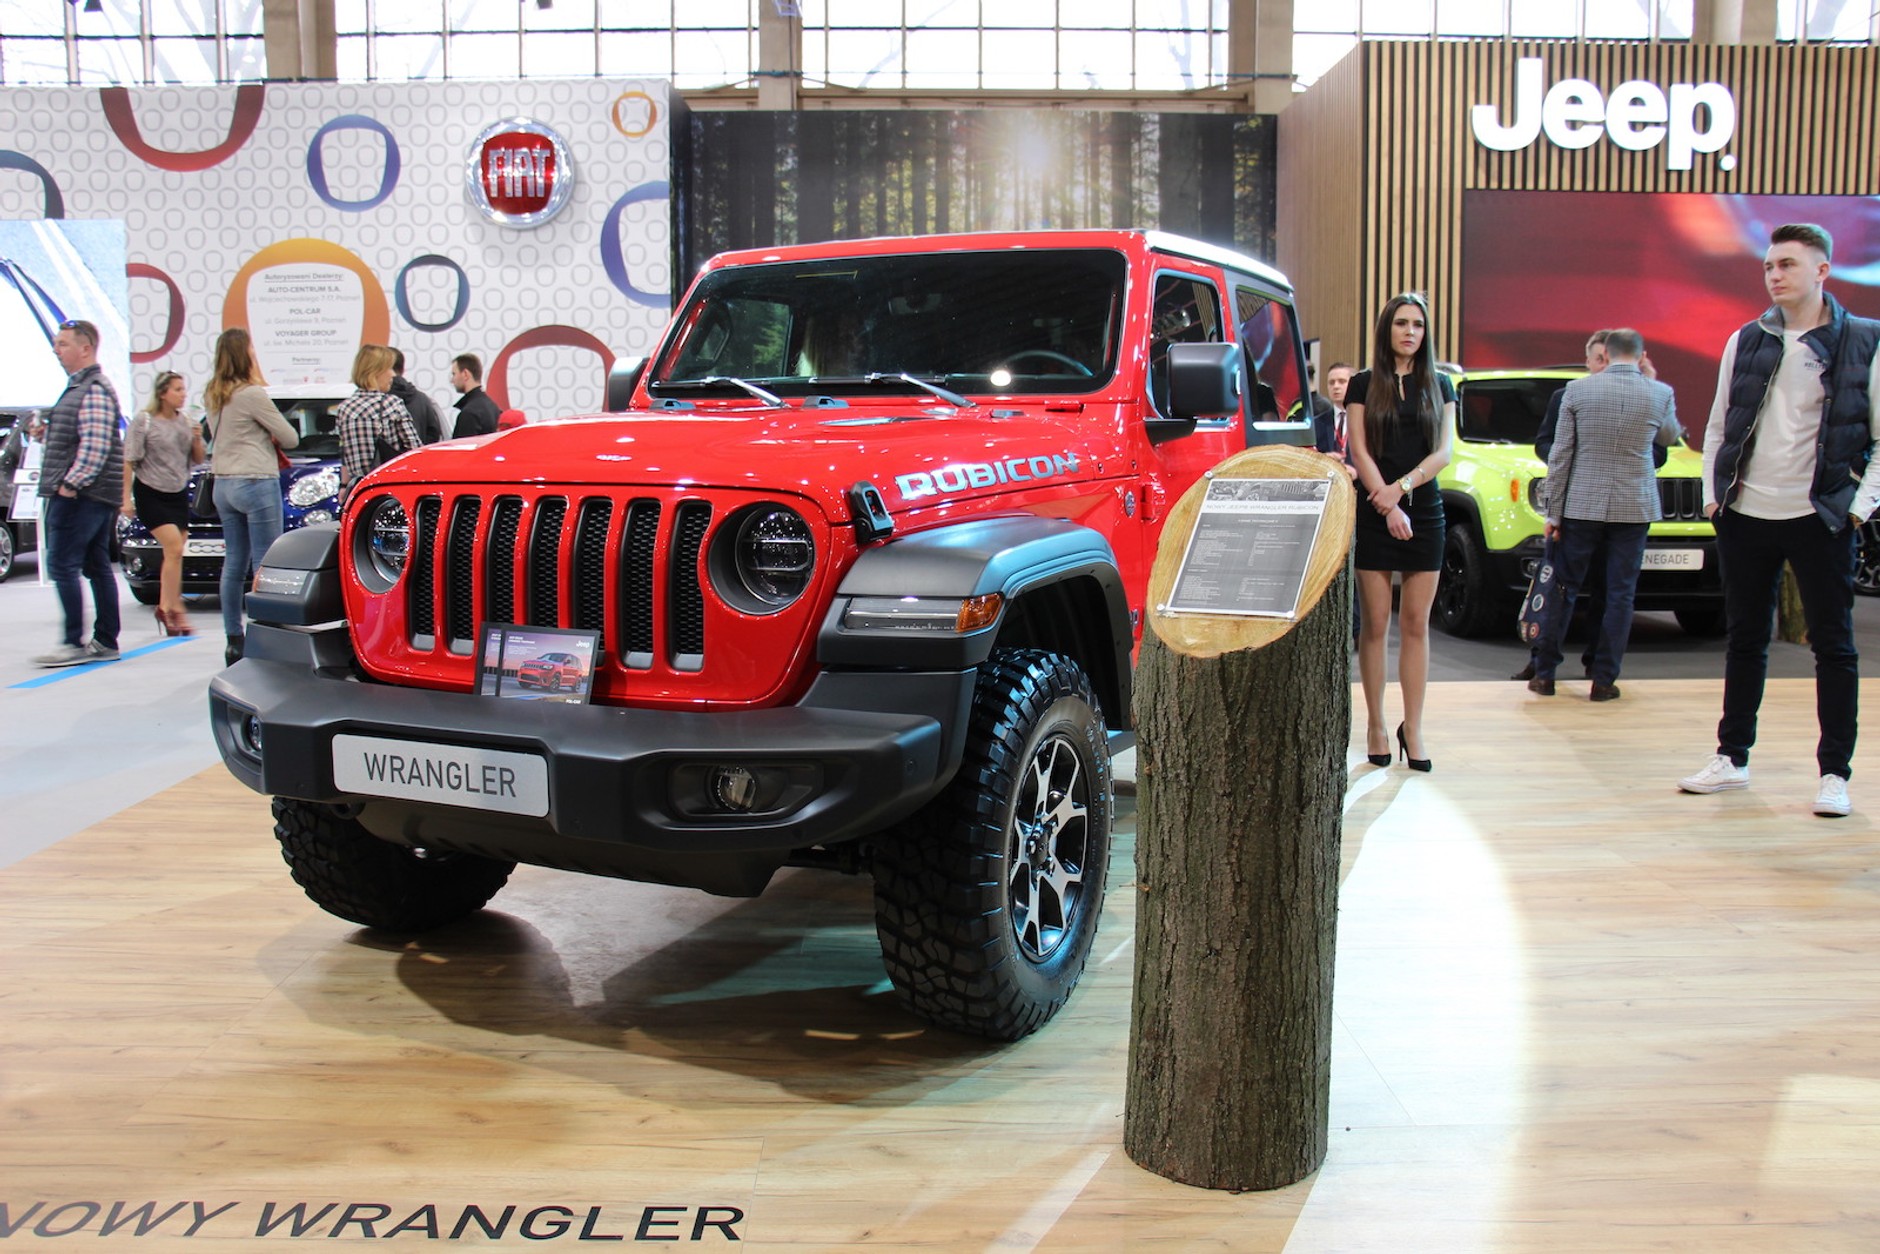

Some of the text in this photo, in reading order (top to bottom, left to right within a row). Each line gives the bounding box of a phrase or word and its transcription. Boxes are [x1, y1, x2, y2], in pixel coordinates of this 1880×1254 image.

[488, 147, 550, 198] FIAT
[268, 286, 326, 294] AUTO-CENTRUM
[895, 452, 1079, 500] RUBICON
[1641, 554, 1689, 564] NEGADE
[364, 752, 516, 798] WRANGLER
[255, 1203, 744, 1241] WRANGLER
